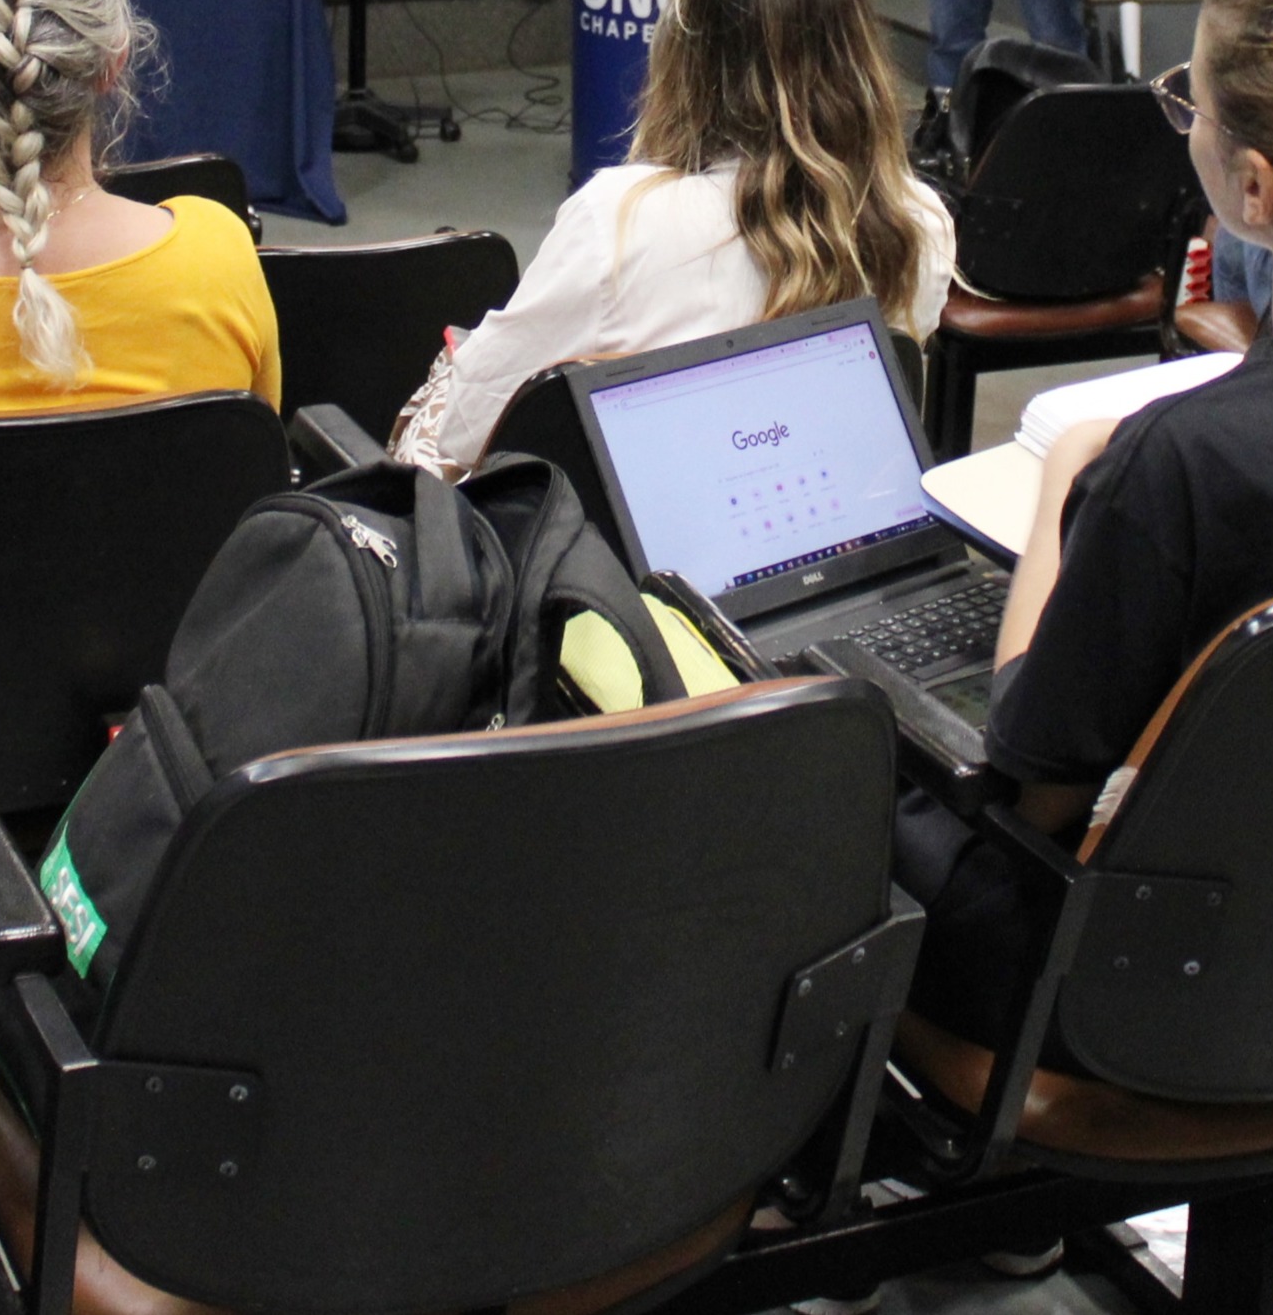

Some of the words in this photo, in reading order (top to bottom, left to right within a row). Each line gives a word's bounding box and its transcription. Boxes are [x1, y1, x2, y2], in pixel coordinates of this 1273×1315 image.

[580, 12, 655, 43] CHAPE
[732, 421, 790, 450] Google
[802, 571, 824, 586] DELL
